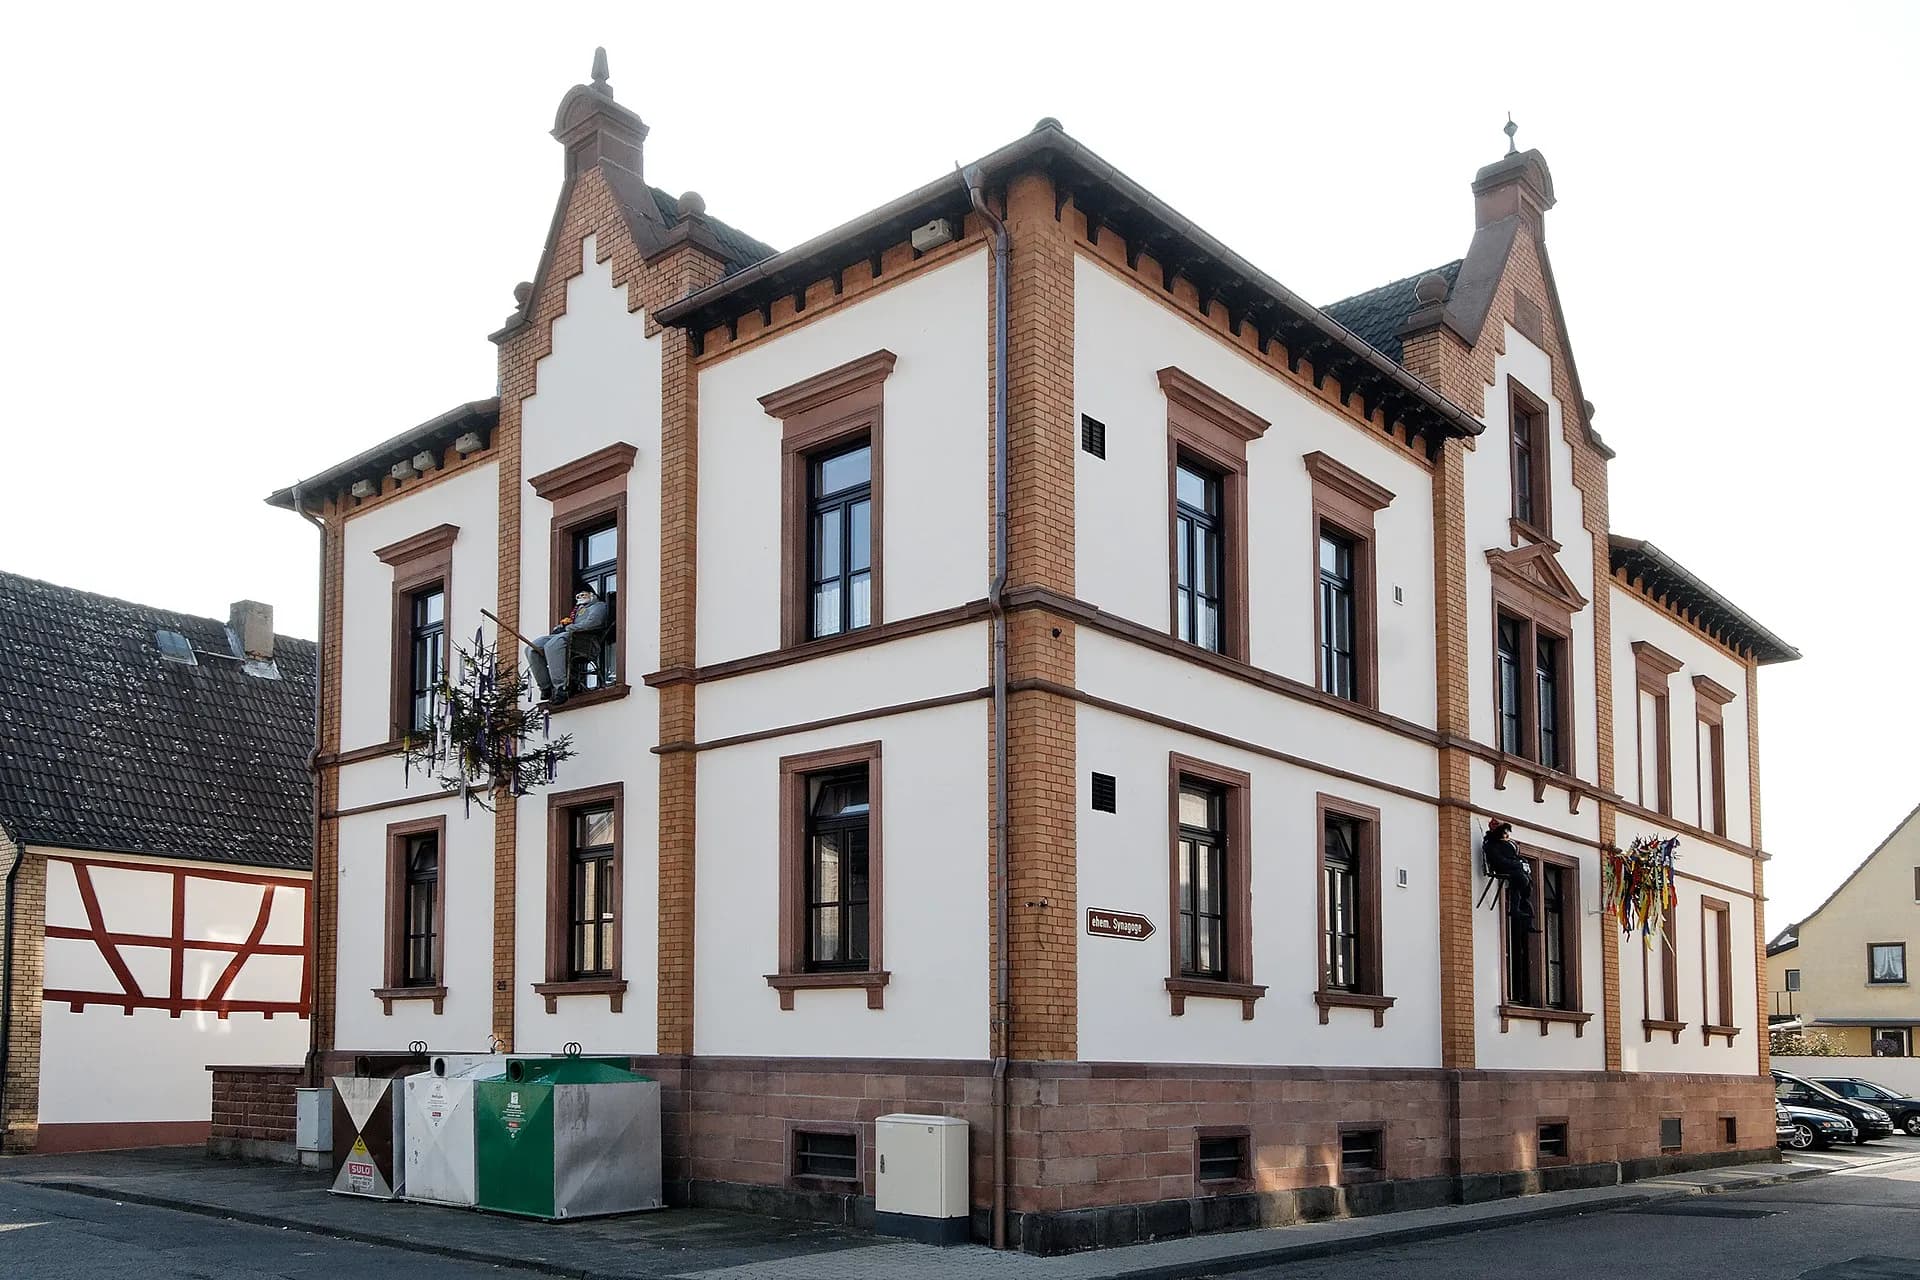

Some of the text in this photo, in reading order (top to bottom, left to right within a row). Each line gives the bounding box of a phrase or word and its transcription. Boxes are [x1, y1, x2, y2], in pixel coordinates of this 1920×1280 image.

[1092, 916, 1142, 935] ehem. Synagoge
[351, 1165, 370, 1175] SULO
